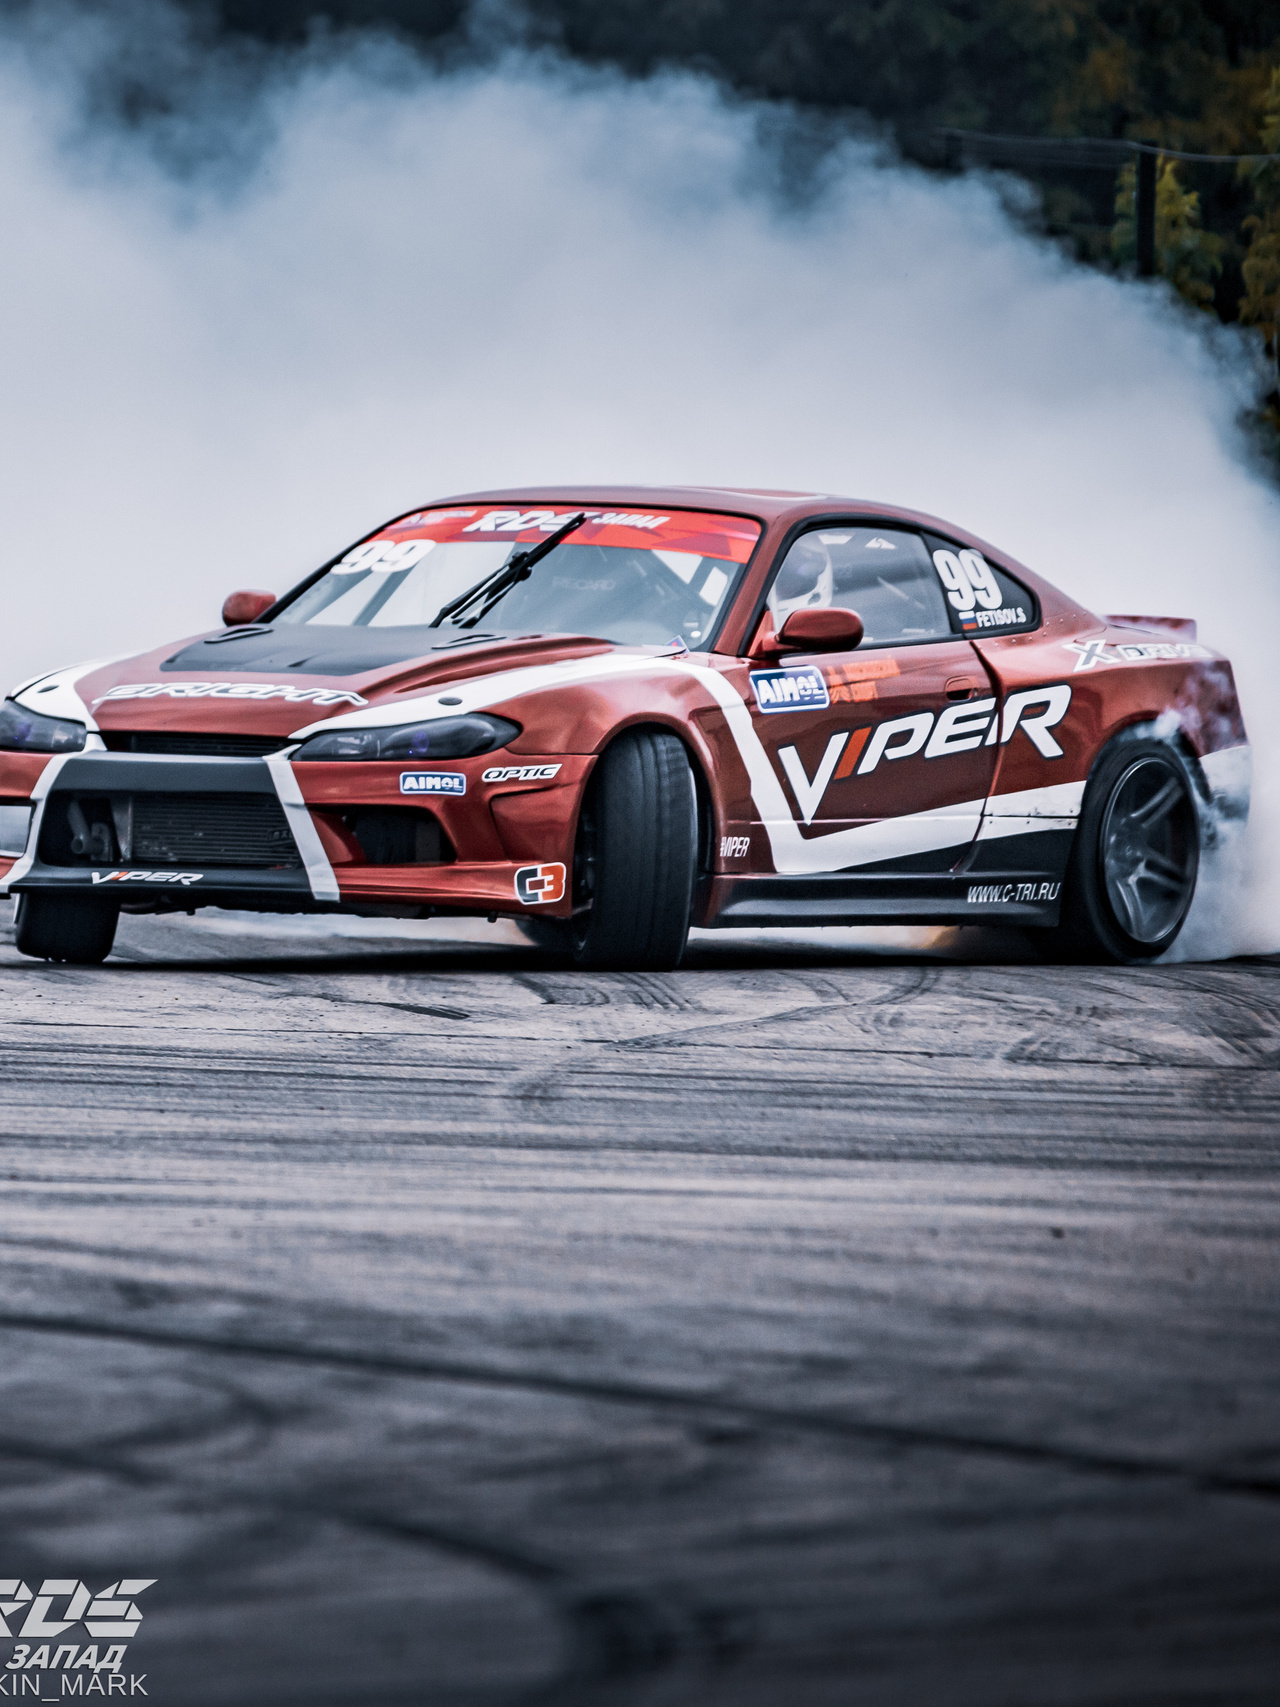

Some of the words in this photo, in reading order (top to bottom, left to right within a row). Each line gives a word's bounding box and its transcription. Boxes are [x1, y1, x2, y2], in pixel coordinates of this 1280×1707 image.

[331, 539, 437, 575] 99
[932, 549, 1003, 611] 99
[975, 607, 1027, 629] FETISOV.S
[1063, 639, 1122, 673] X
[91, 682, 369, 707] BRIGHT
[757, 675, 824, 704] AIMOL
[777, 684, 1071, 826] VIPER
[403, 776, 463, 790] AIMOL
[483, 765, 562, 782] OPTIC
[91, 871, 204, 885] VIPER
[515, 863, 567, 905] C3
[967, 883, 1061, 903] WWW.C-TRI.RU
